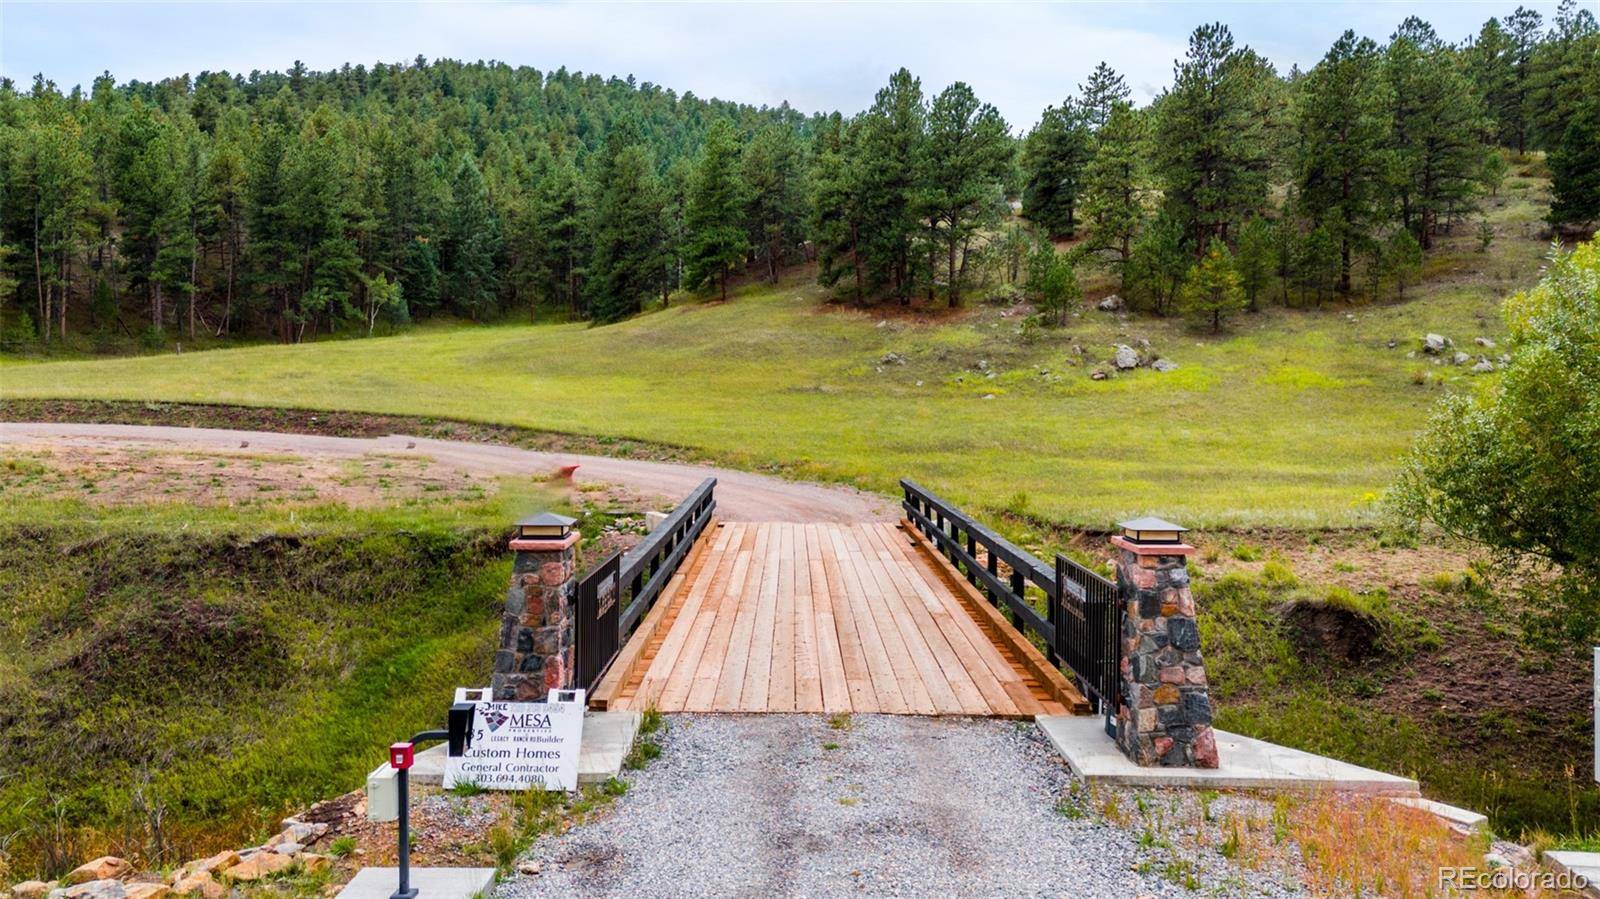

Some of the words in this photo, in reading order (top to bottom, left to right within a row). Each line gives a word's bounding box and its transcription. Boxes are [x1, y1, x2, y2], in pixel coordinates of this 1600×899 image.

[509, 714, 552, 728] MESA
[516, 747, 561, 759] Homes
[461, 762, 502, 772] General
[505, 763, 559, 773] Contractor
